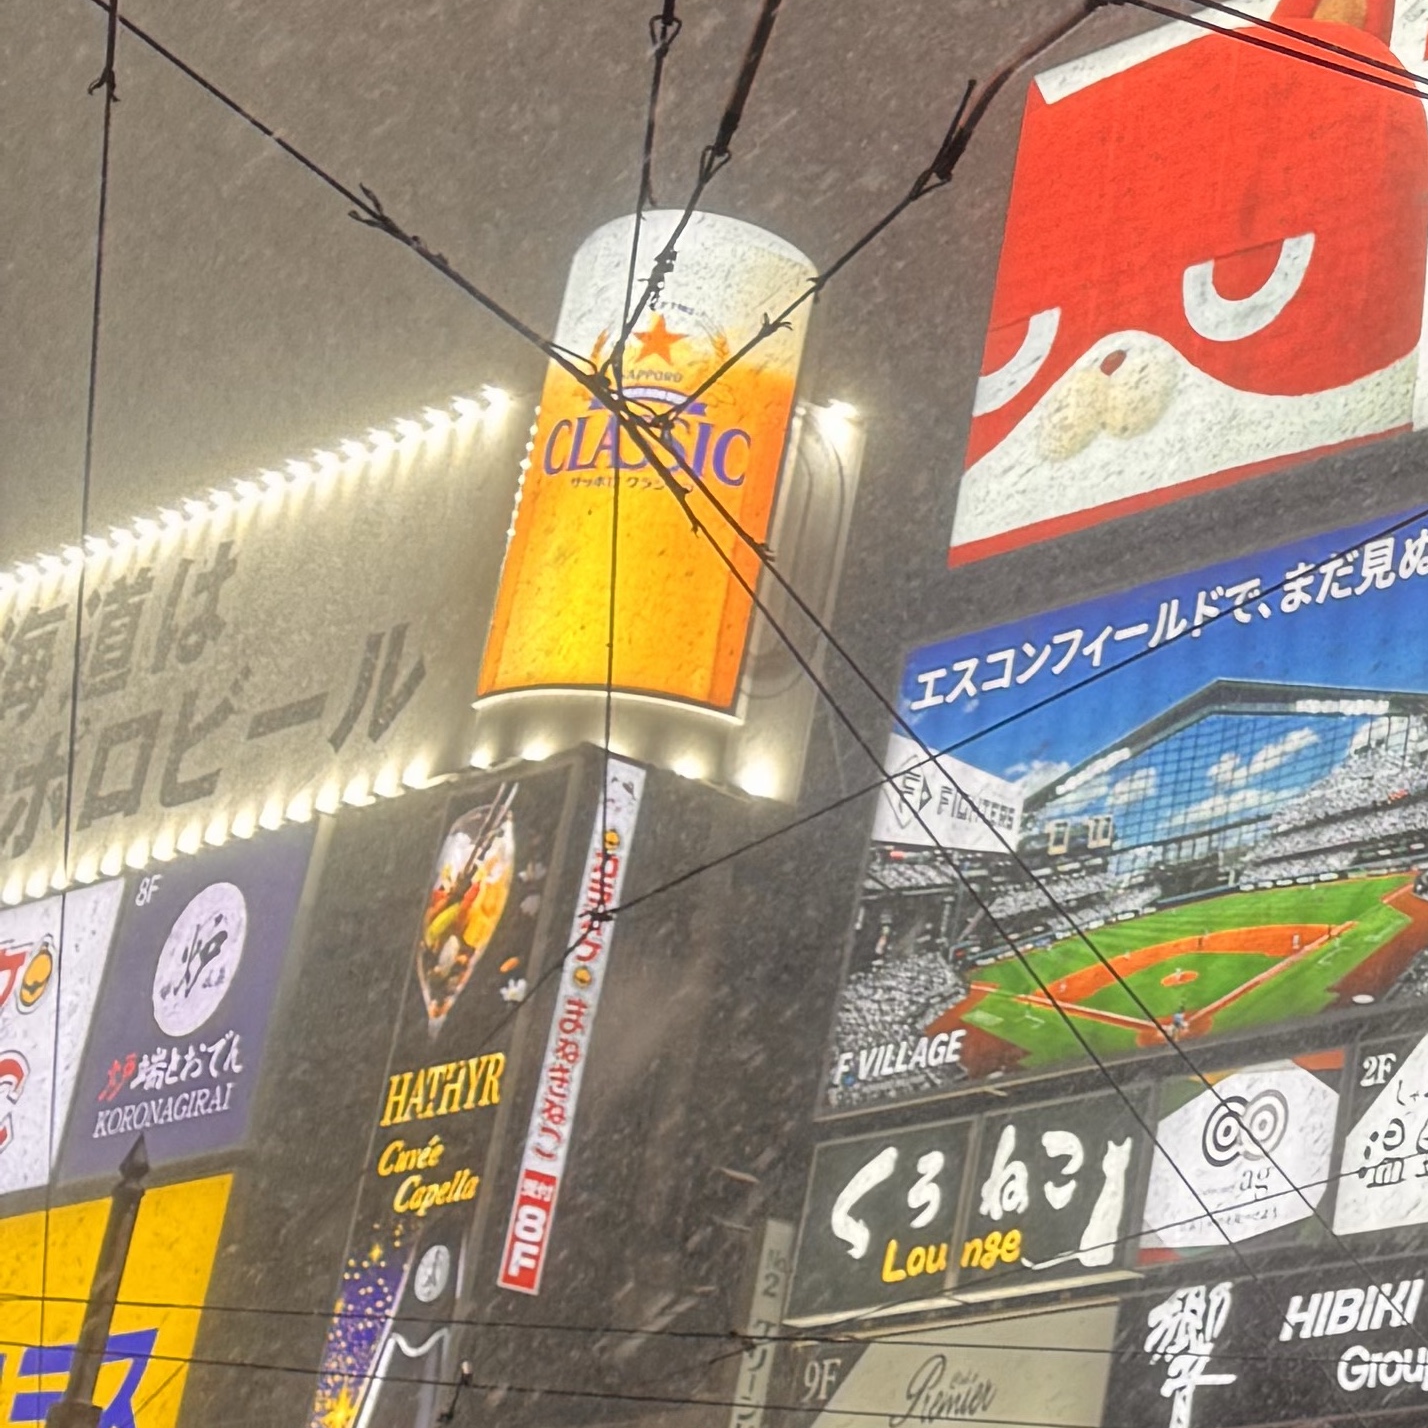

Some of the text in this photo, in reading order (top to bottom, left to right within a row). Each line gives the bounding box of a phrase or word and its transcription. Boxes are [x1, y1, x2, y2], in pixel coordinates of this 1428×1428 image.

[135, 874, 162, 906] 8F
[856, 1027, 970, 1084] VILLAGE
[1359, 1053, 1397, 1087] 2F
[91, 1082, 236, 1139] KORONAGIRAI
[379, 1051, 507, 1128] HATHYR
[392, 1169, 481, 1219] Capella
[830, 1124, 1083, 1262] くろねこ
[882, 1227, 1023, 1284] Lounge
[1278, 1276, 1426, 1345] HIBIKI
[803, 1358, 842, 1403] 9F
